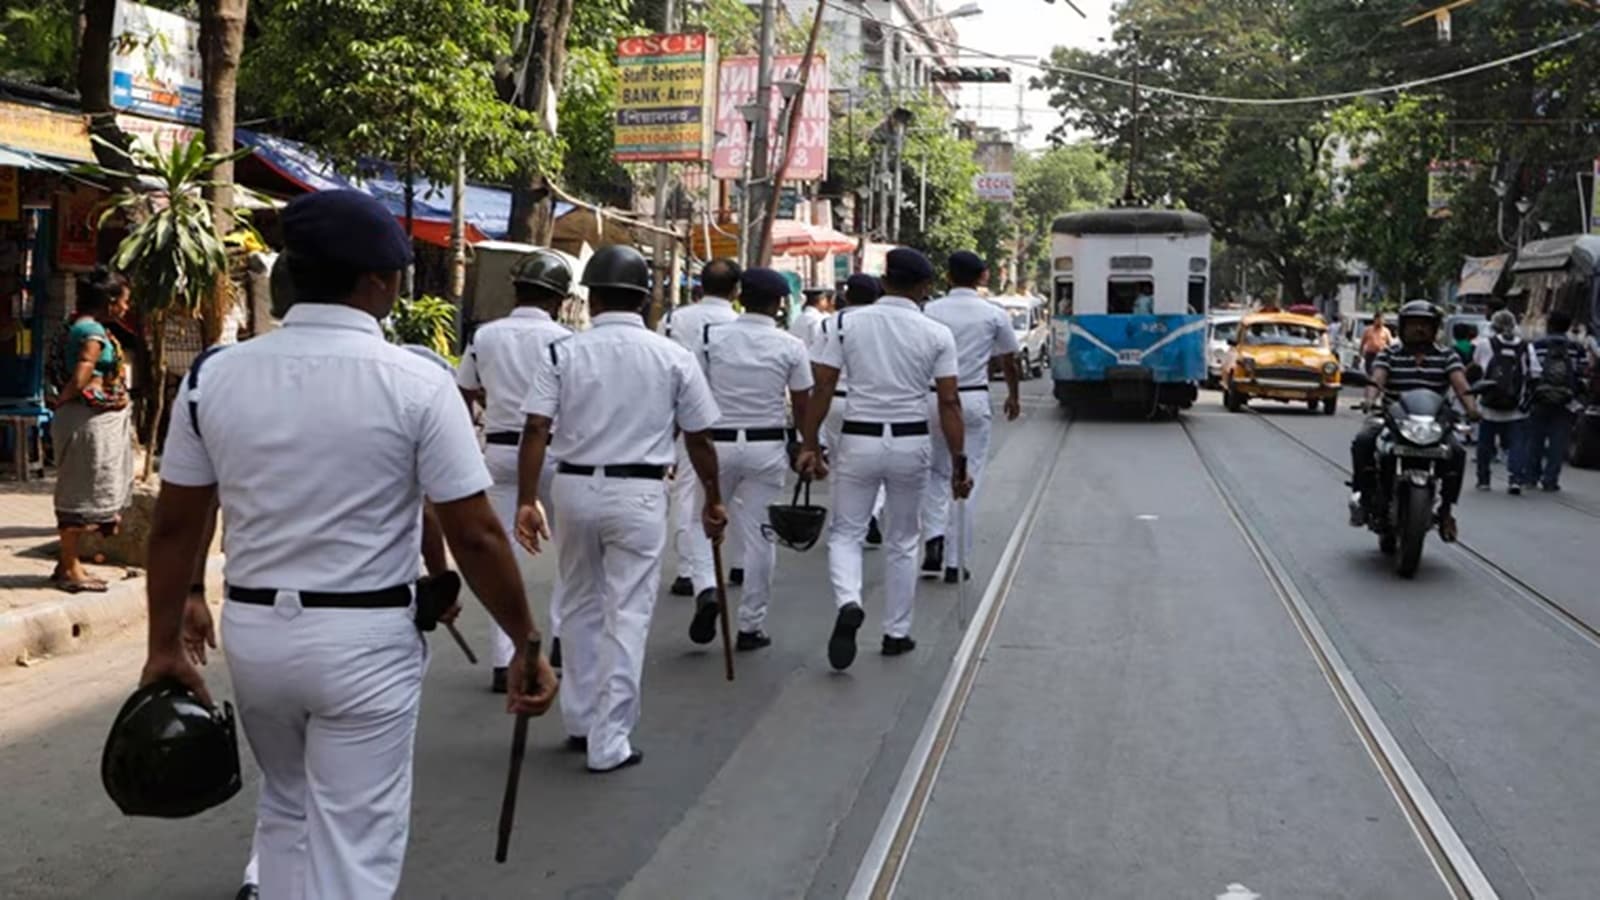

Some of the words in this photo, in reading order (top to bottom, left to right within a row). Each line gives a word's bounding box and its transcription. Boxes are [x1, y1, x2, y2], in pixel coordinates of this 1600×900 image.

[620, 34, 703, 55] GSCE
[623, 66, 649, 83] Staff
[651, 63, 702, 81] Selection
[623, 88, 660, 105] BANK
[668, 87, 702, 105] Army
[976, 177, 1011, 190] CECIL
